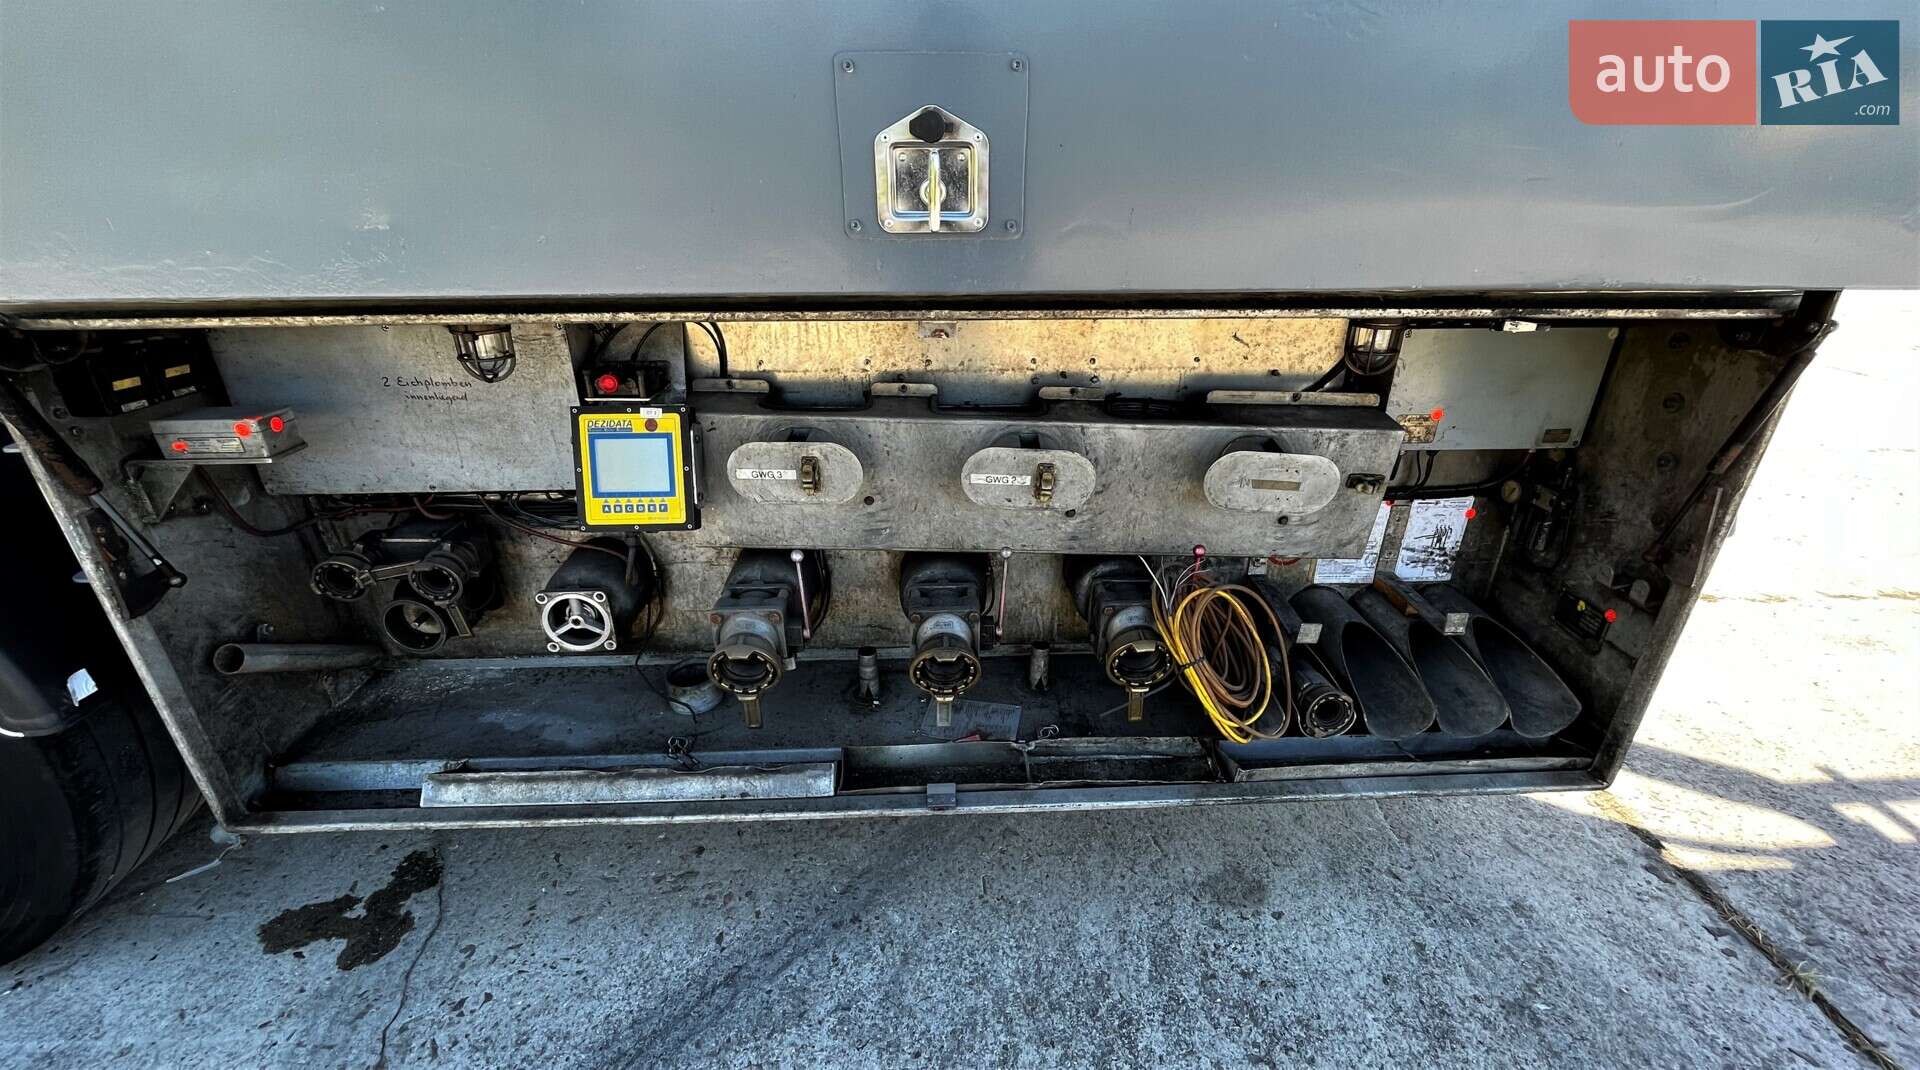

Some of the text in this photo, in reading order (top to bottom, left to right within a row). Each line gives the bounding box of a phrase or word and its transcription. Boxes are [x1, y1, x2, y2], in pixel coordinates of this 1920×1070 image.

[382, 376, 472, 391] 2 Eichplomben
[587, 419, 633, 428] DEZIDATA
[751, 470, 783, 479] GWG 3
[985, 475, 1009, 484] GWG
